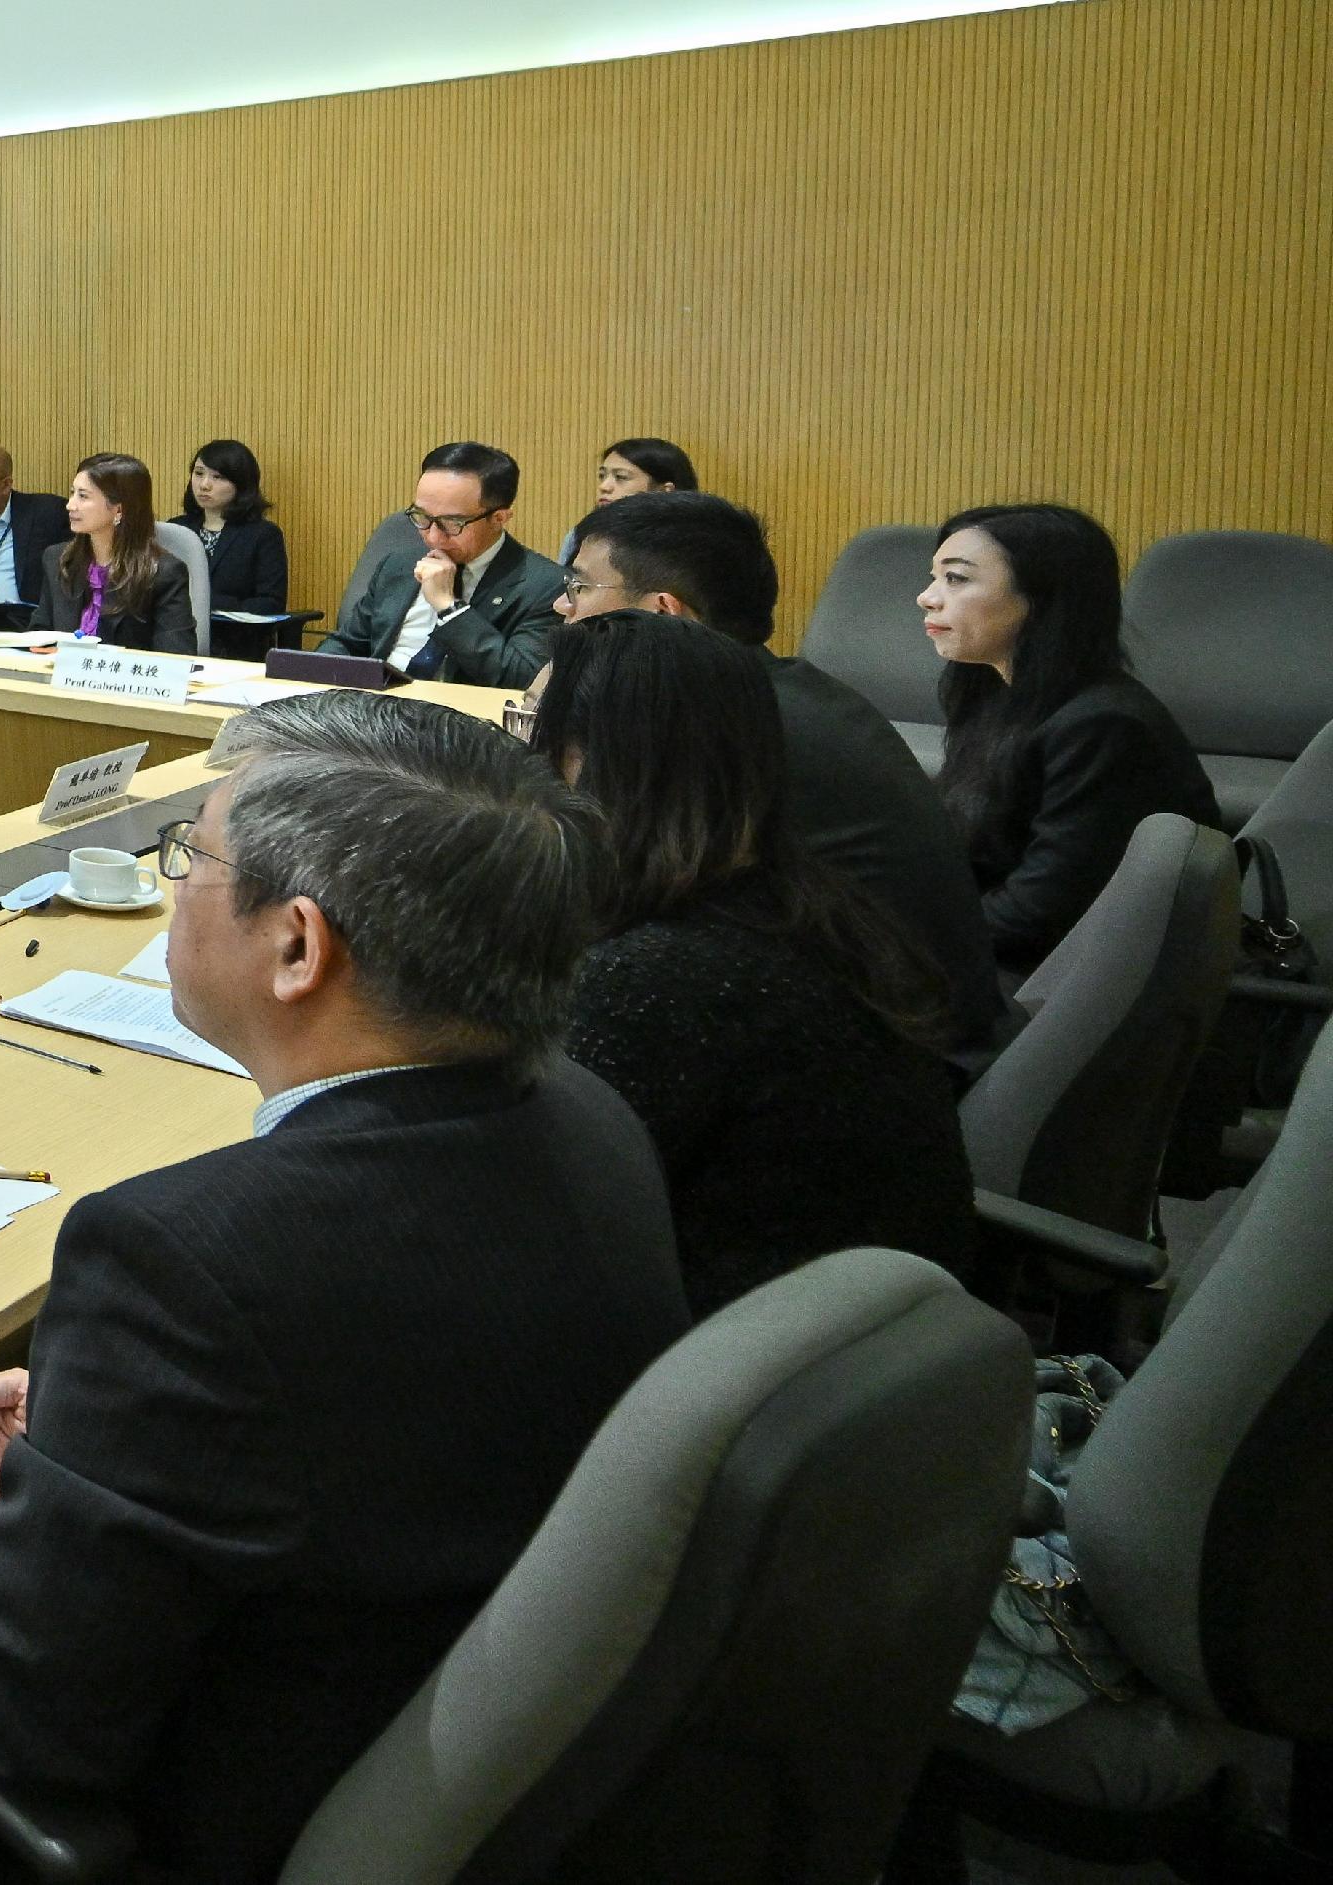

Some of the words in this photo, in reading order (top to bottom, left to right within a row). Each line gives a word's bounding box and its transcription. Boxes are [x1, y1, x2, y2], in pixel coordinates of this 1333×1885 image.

[82, 657, 121, 674] 梁卓偉
[132, 664, 159, 678] 教授
[65, 677, 87, 688] Prof
[88, 680, 126, 693] Gabriel
[128, 684, 171, 698] LEUNG
